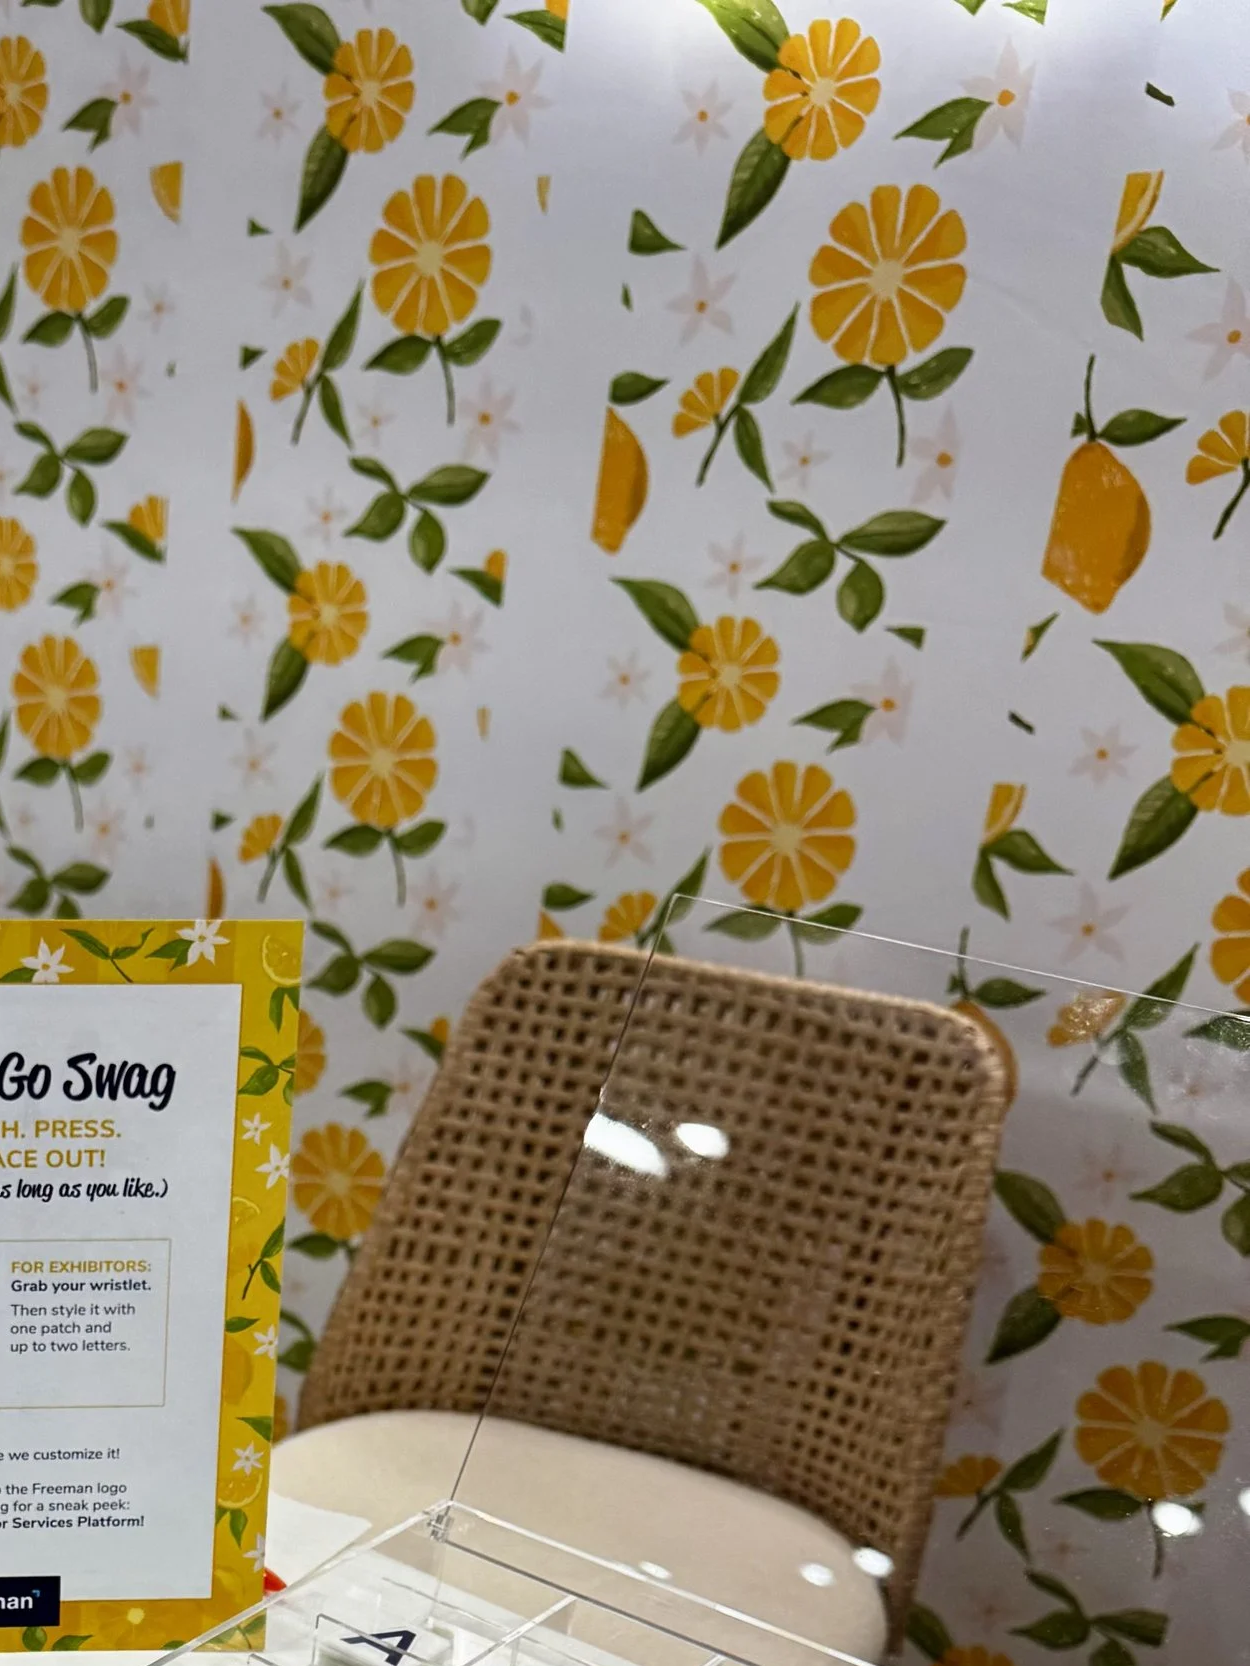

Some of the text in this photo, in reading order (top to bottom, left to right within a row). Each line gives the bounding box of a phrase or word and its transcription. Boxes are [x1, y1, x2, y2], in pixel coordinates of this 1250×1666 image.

[62, 1052, 176, 1111] Swag
[35, 1119, 122, 1138] PRESS.
[46, 1149, 106, 1168] OUT!
[16, 1178, 54, 1203] long
[59, 1183, 81, 1198] as
[86, 1183, 119, 1202] you
[122, 1177, 168, 1198] like.)
[11, 1260, 151, 1273] FOR EXHIBITORS:
[11, 1279, 151, 1294] Grab your wristlet.
[11, 1303, 136, 1318] Then style it with
[10, 1321, 112, 1336] one patch and
[10, 1339, 131, 1355] up to two letters.
[8, 1451, 30, 1461] we
[33, 1448, 103, 1460] customize
[107, 1448, 120, 1459] it!
[5, 1483, 28, 1495] the
[32, 1483, 93, 1494] Freeman
[97, 1482, 127, 1495] logo
[13, 1501, 33, 1512] for
[36, 1503, 44, 1512] a
[48, 1500, 88, 1511] sneak
[93, 1499, 130, 1512] peek:
[12, 1517, 73, 1529] Services
[77, 1516, 145, 1528] Platform!
